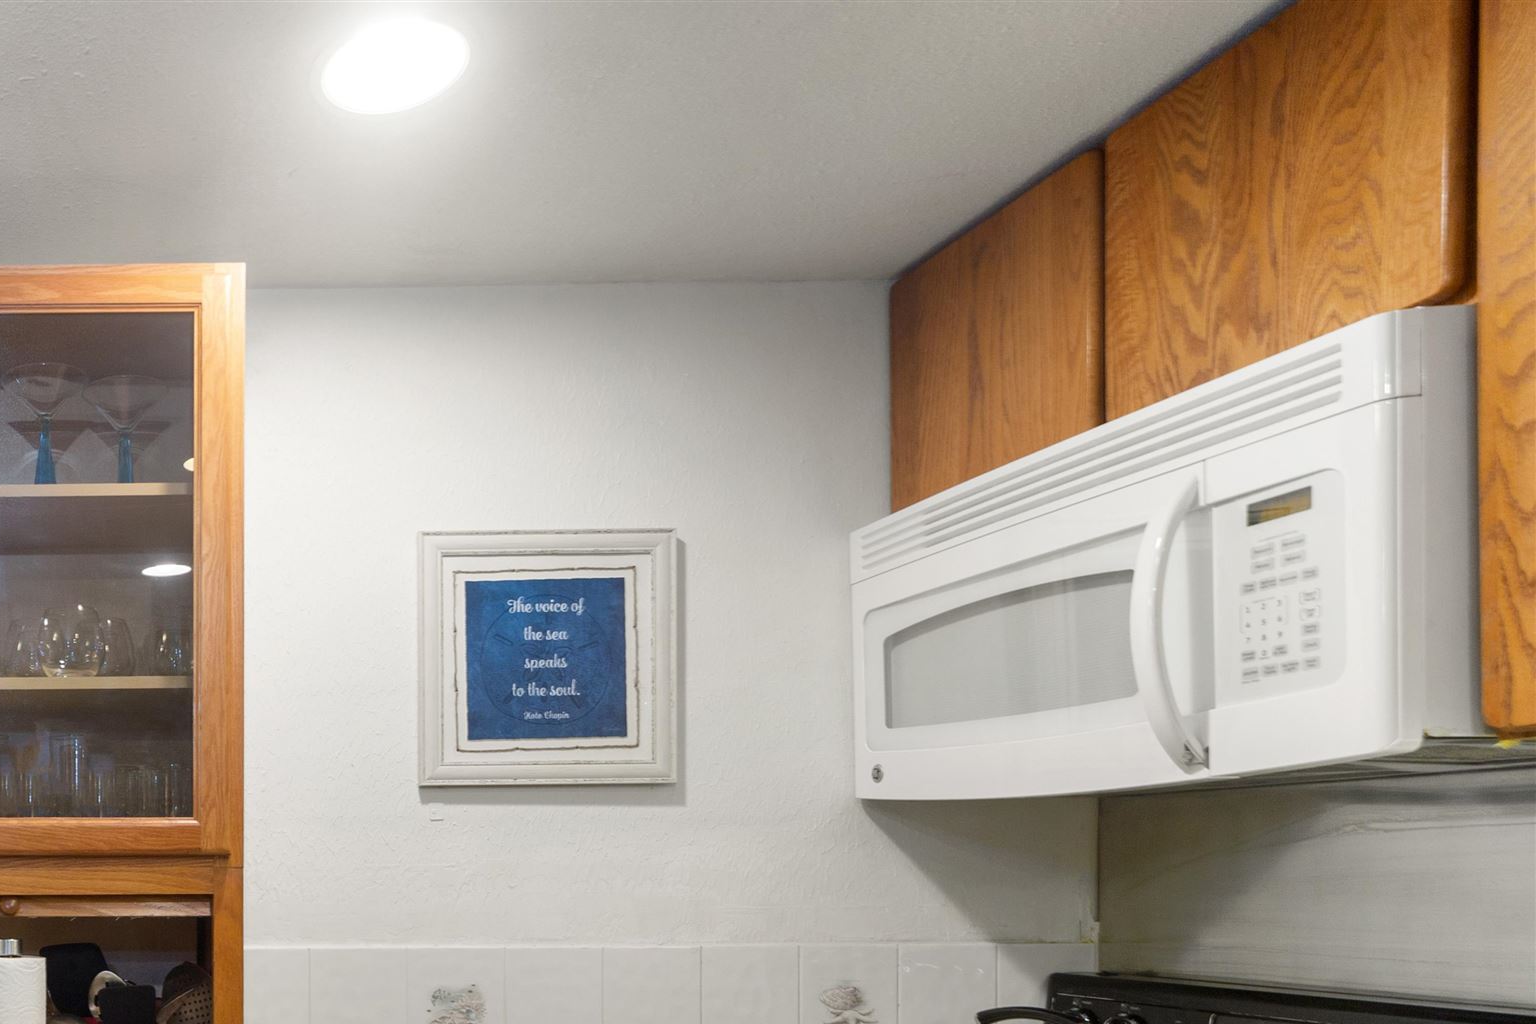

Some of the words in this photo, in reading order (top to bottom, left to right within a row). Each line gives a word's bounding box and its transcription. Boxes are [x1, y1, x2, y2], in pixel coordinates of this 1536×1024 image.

[507, 596, 534, 613] The
[535, 599, 569, 613] voice
[570, 597, 585, 616] of
[524, 625, 544, 640] the
[545, 629, 569, 640] sea
[524, 653, 568, 672] speaks
[512, 683, 525, 697] to
[527, 681, 547, 697] the
[549, 678, 581, 697] soul.
[544, 710, 570, 720] Chopin
